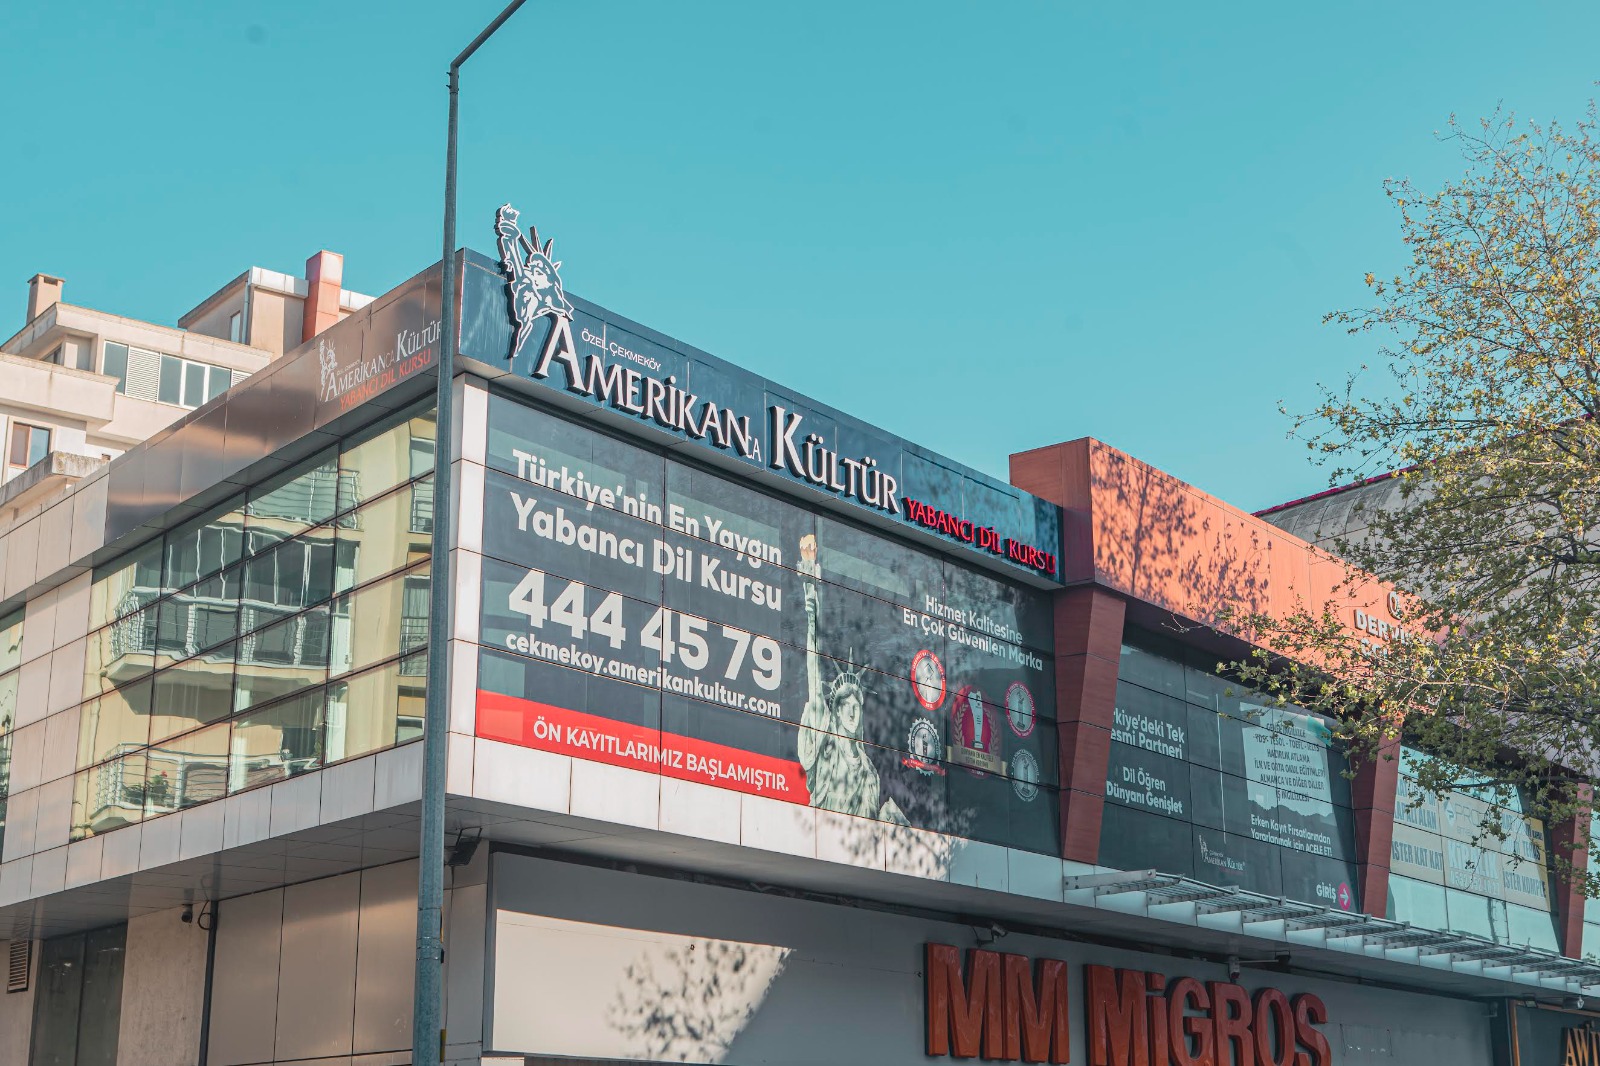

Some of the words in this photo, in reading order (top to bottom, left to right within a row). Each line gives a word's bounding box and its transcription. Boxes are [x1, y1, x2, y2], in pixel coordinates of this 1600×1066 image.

[581, 328, 608, 350] ÖZEL
[609, 342, 661, 372] ÇEKMEKÖY
[340, 377, 379, 411] YABANCI
[399, 348, 431, 378] KURSU
[769, 405, 900, 514] KÜLTÜR
[512, 449, 662, 526] Türkiye'nin
[669, 504, 699, 537] En
[704, 515, 782, 568] Yaygın
[902, 496, 975, 542] YABANCI
[976, 526, 1004, 555] DİL
[1006, 538, 1056, 574] KURSU
[510, 492, 644, 567] Yabancı
[653, 538, 692, 582] Dil
[701, 555, 782, 611] Kursu
[508, 568, 626, 650] 444
[640, 606, 709, 671] 45
[722, 628, 782, 691] 79
[903, 607, 918, 628] En
[920, 614, 945, 637] Çok
[948, 623, 1006, 658] Güvenilen
[1008, 645, 1043, 671] Marka
[925, 594, 966, 625] Hizmet
[969, 610, 1023, 645] Kalitesine
[505, 632, 780, 718] cekmekoy.amerikankultur.com
[533, 716, 561, 742] ÖN
[566, 728, 683, 770] KAYITLARIMIZ
[686, 756, 789, 791] BAŞLAMIŞTIR.
[1138, 732, 1183, 760] Partneri
[1166, 723, 1185, 744] Tek
[1106, 780, 1145, 804] Dünyanı
[1146, 792, 1183, 815] Genişlet
[1122, 766, 1136, 784] Dil
[1137, 767, 1166, 791] Öğren
[1250, 814, 1270, 829] Erken
[1288, 823, 1331, 845] Fırsatlarından
[1250, 828, 1292, 849] Yararlanmak
[1306, 843, 1323, 854] ACELE
[1323, 847, 1333, 857] ET!
[1414, 845, 1428, 867] KAT
[1315, 882, 1337, 903] GİRİŞ
[924, 941, 1070, 1064] MM
